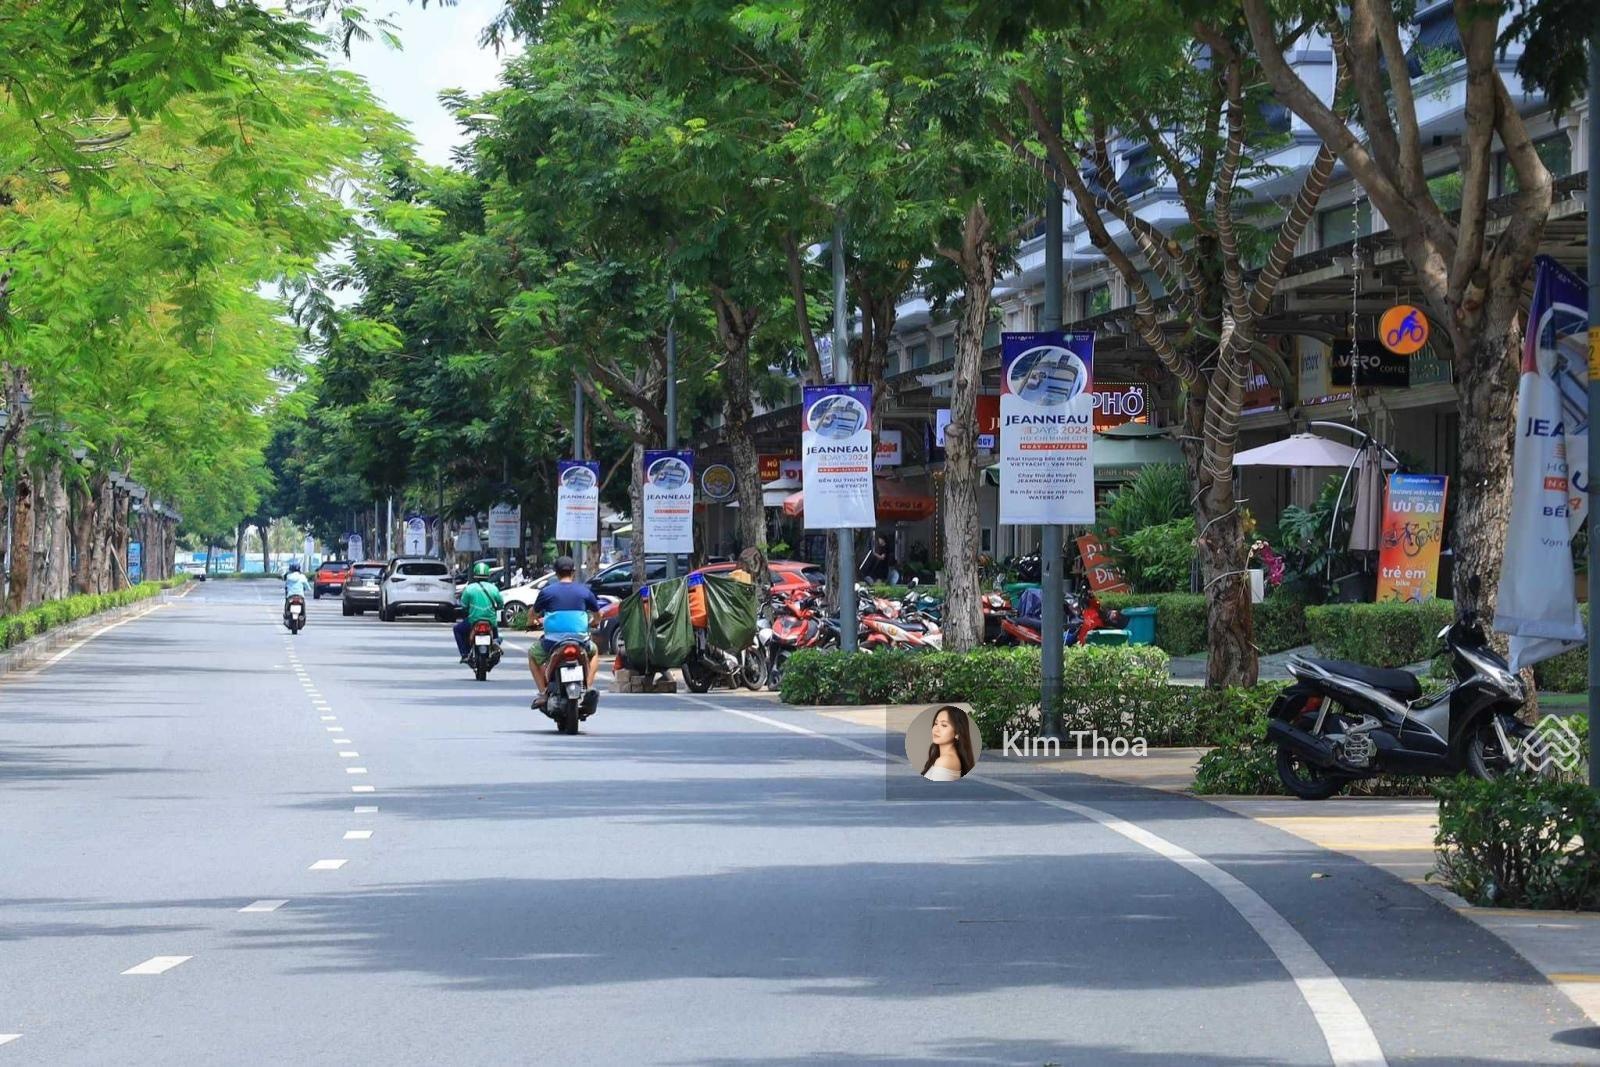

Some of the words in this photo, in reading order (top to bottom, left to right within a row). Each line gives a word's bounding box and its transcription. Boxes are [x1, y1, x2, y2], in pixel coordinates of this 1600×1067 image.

[1005, 415, 1088, 426] JEANNEAU
[1062, 426, 1088, 434] 2024
[807, 446, 868, 455] JEANNEAU
[1393, 500, 1411, 512] ƯU
[1383, 565, 1401, 578] trẻ
[1405, 569, 1426, 579] em
